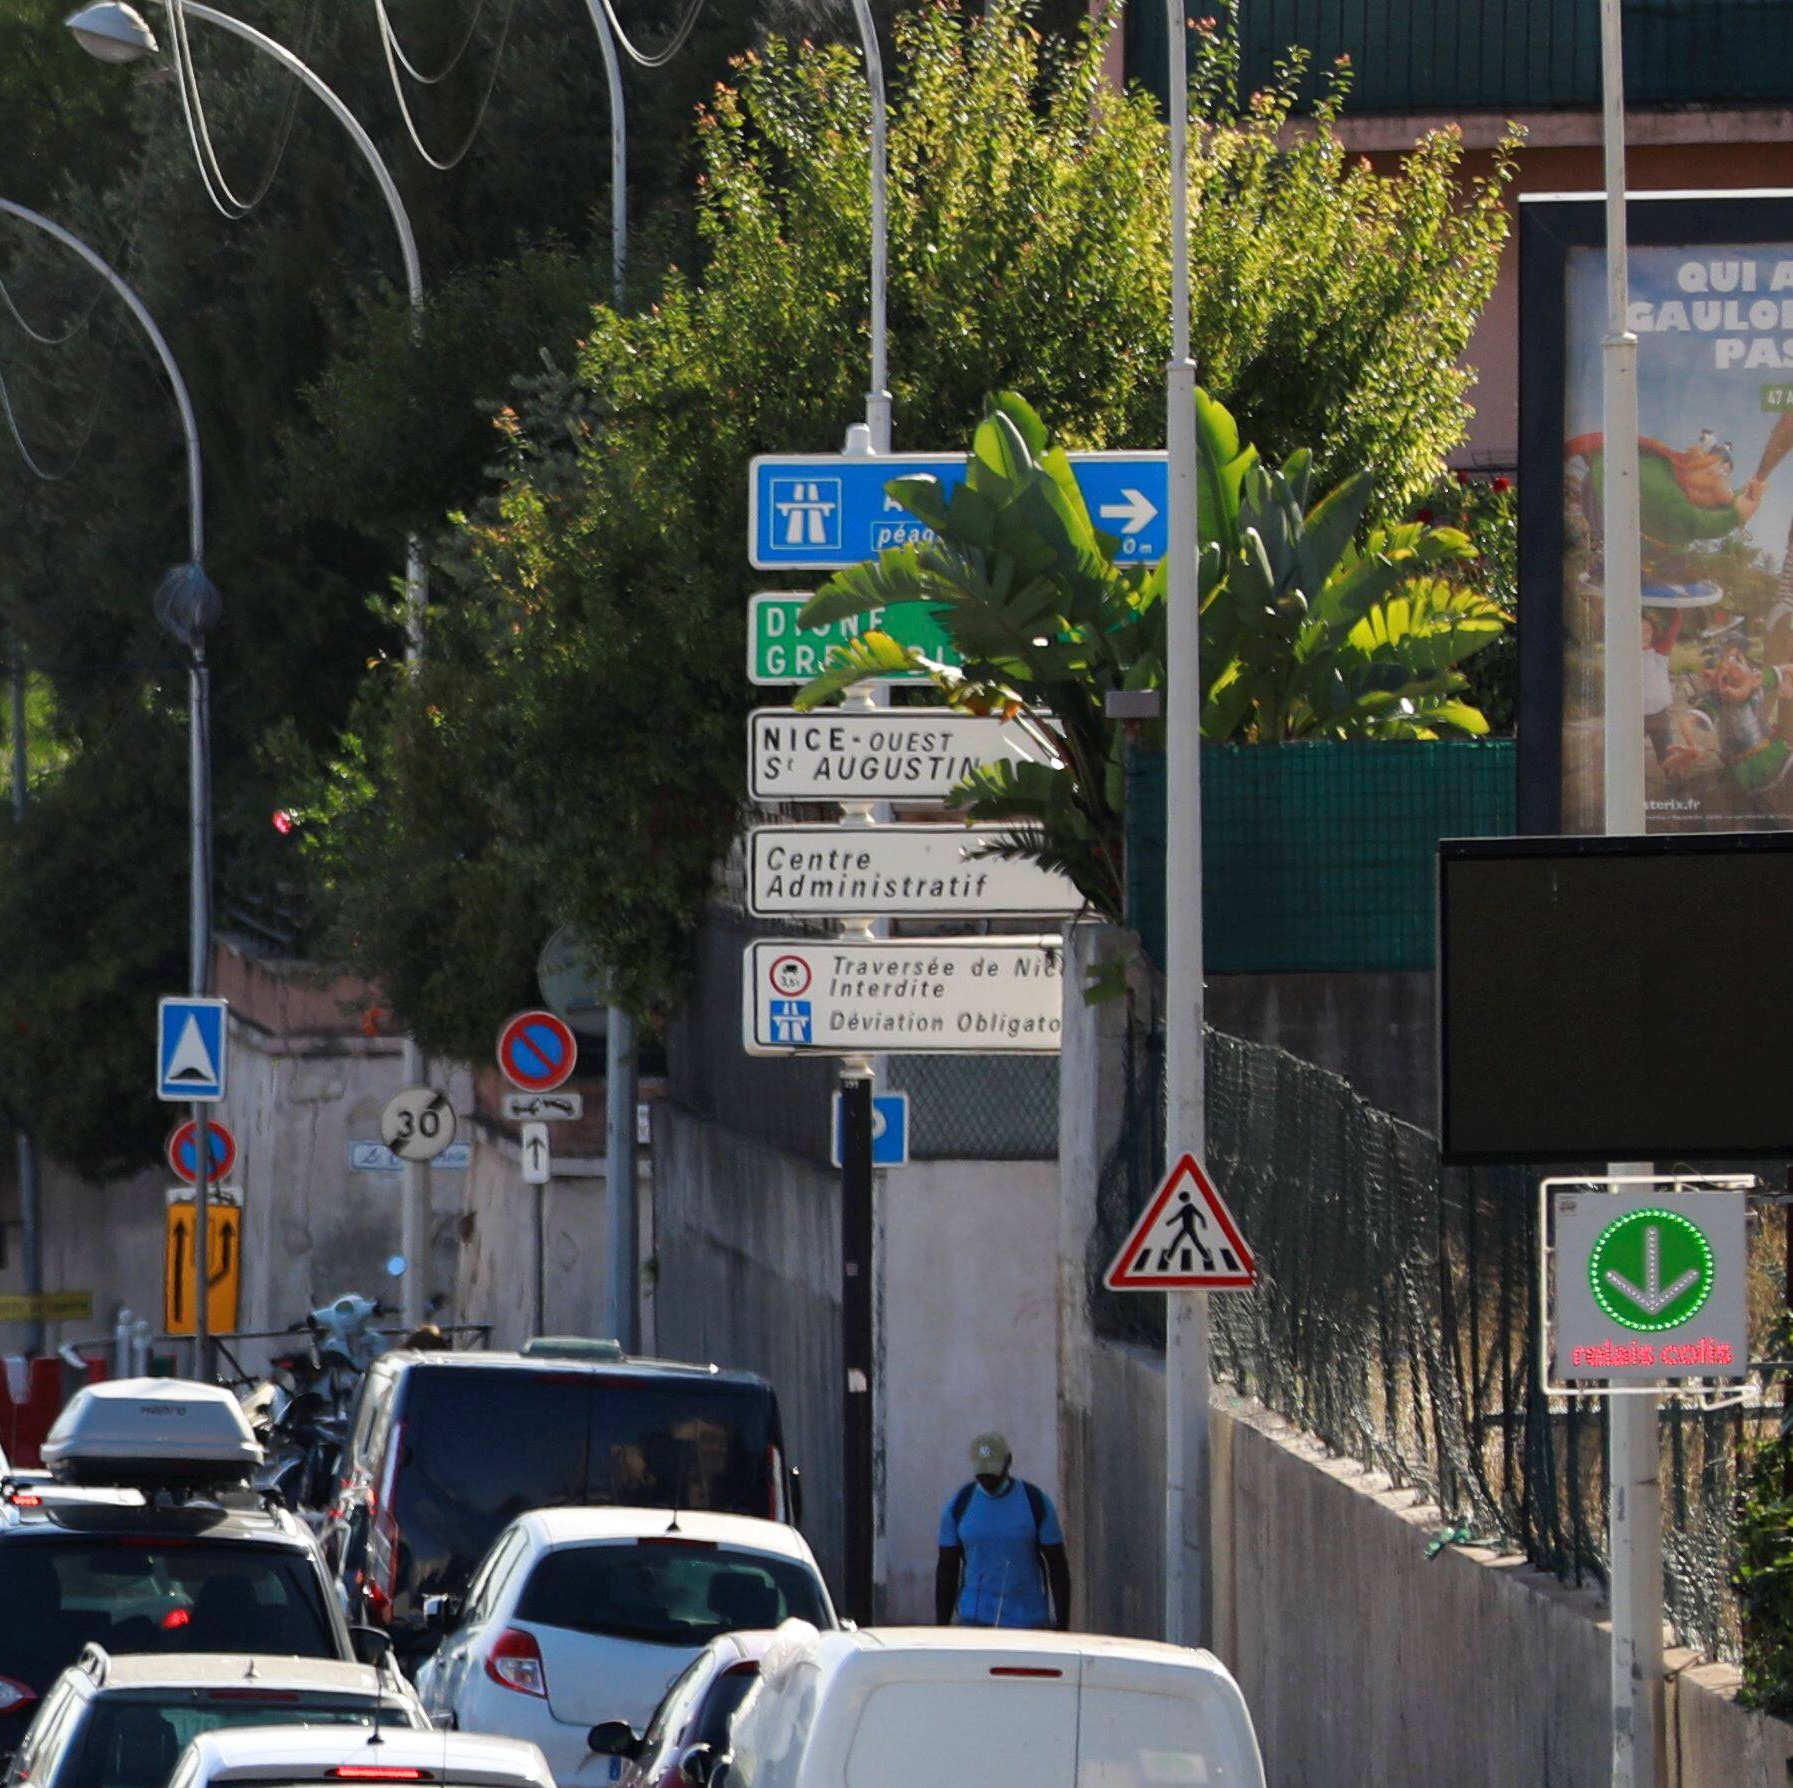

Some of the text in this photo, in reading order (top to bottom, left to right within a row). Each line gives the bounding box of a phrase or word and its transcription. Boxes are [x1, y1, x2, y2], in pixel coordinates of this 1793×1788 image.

[1678, 261, 1757, 292] QUI
[814, 757, 980, 781] AUGUSTIN
[767, 847, 871, 872] Centre
[767, 874, 988, 899] Administratif
[833, 955, 1063, 977] Traversée de Nic
[829, 978, 945, 998] Interdite
[829, 1008, 944, 1032] Déviation
[397, 1110, 439, 1138] 30
[1573, 1336, 1734, 1367] relais colis
